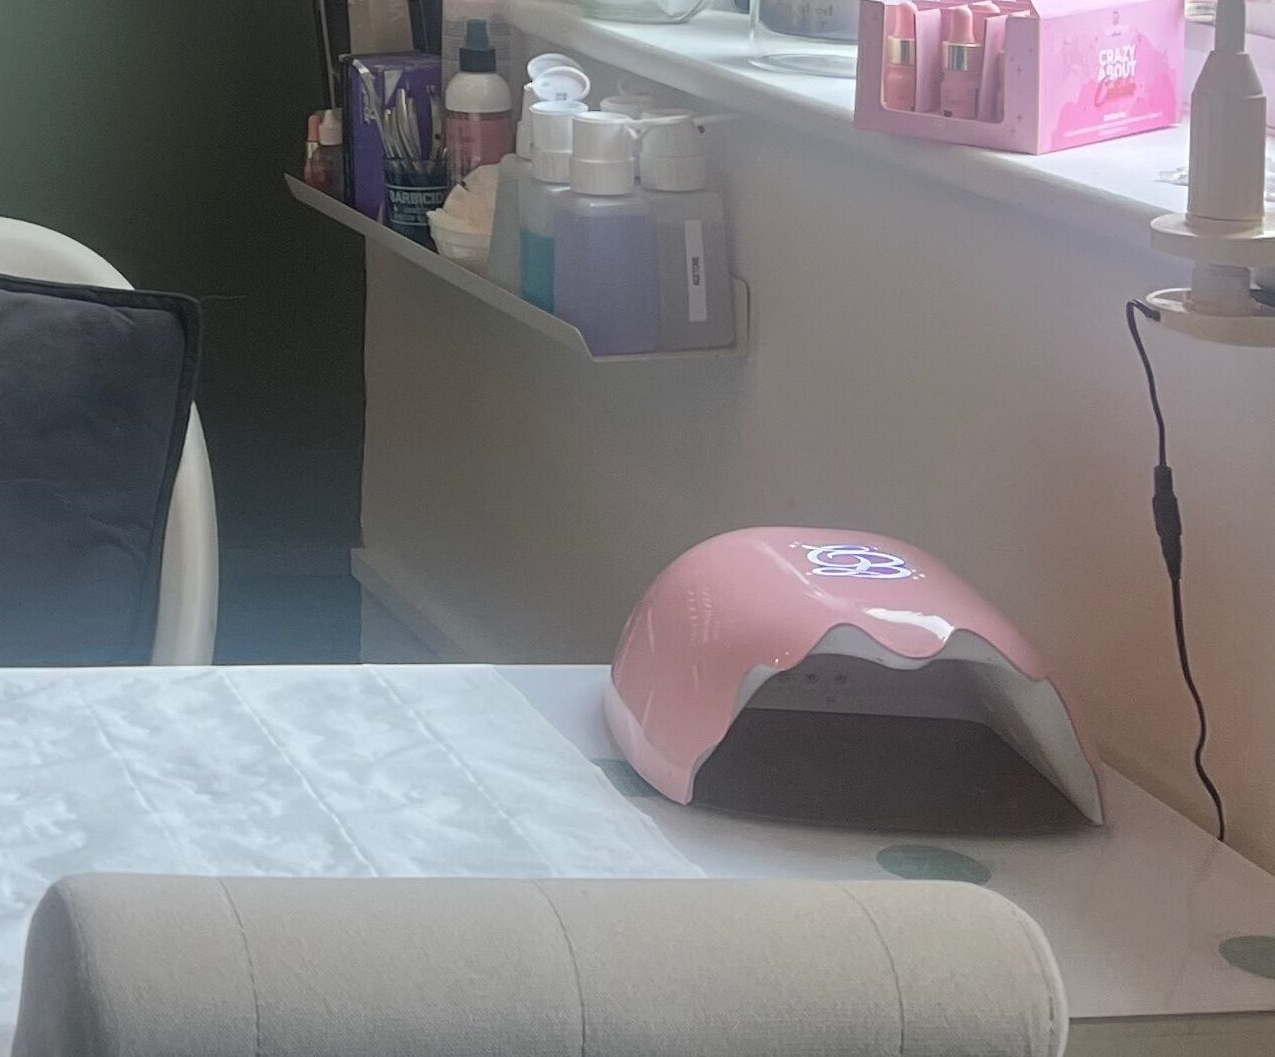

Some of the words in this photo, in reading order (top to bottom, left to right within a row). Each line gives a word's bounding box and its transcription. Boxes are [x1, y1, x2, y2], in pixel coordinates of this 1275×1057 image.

[1098, 44, 1137, 65] CRAZY
[1097, 60, 1138, 84] ABOUT
[389, 190, 444, 205] BARBICID
